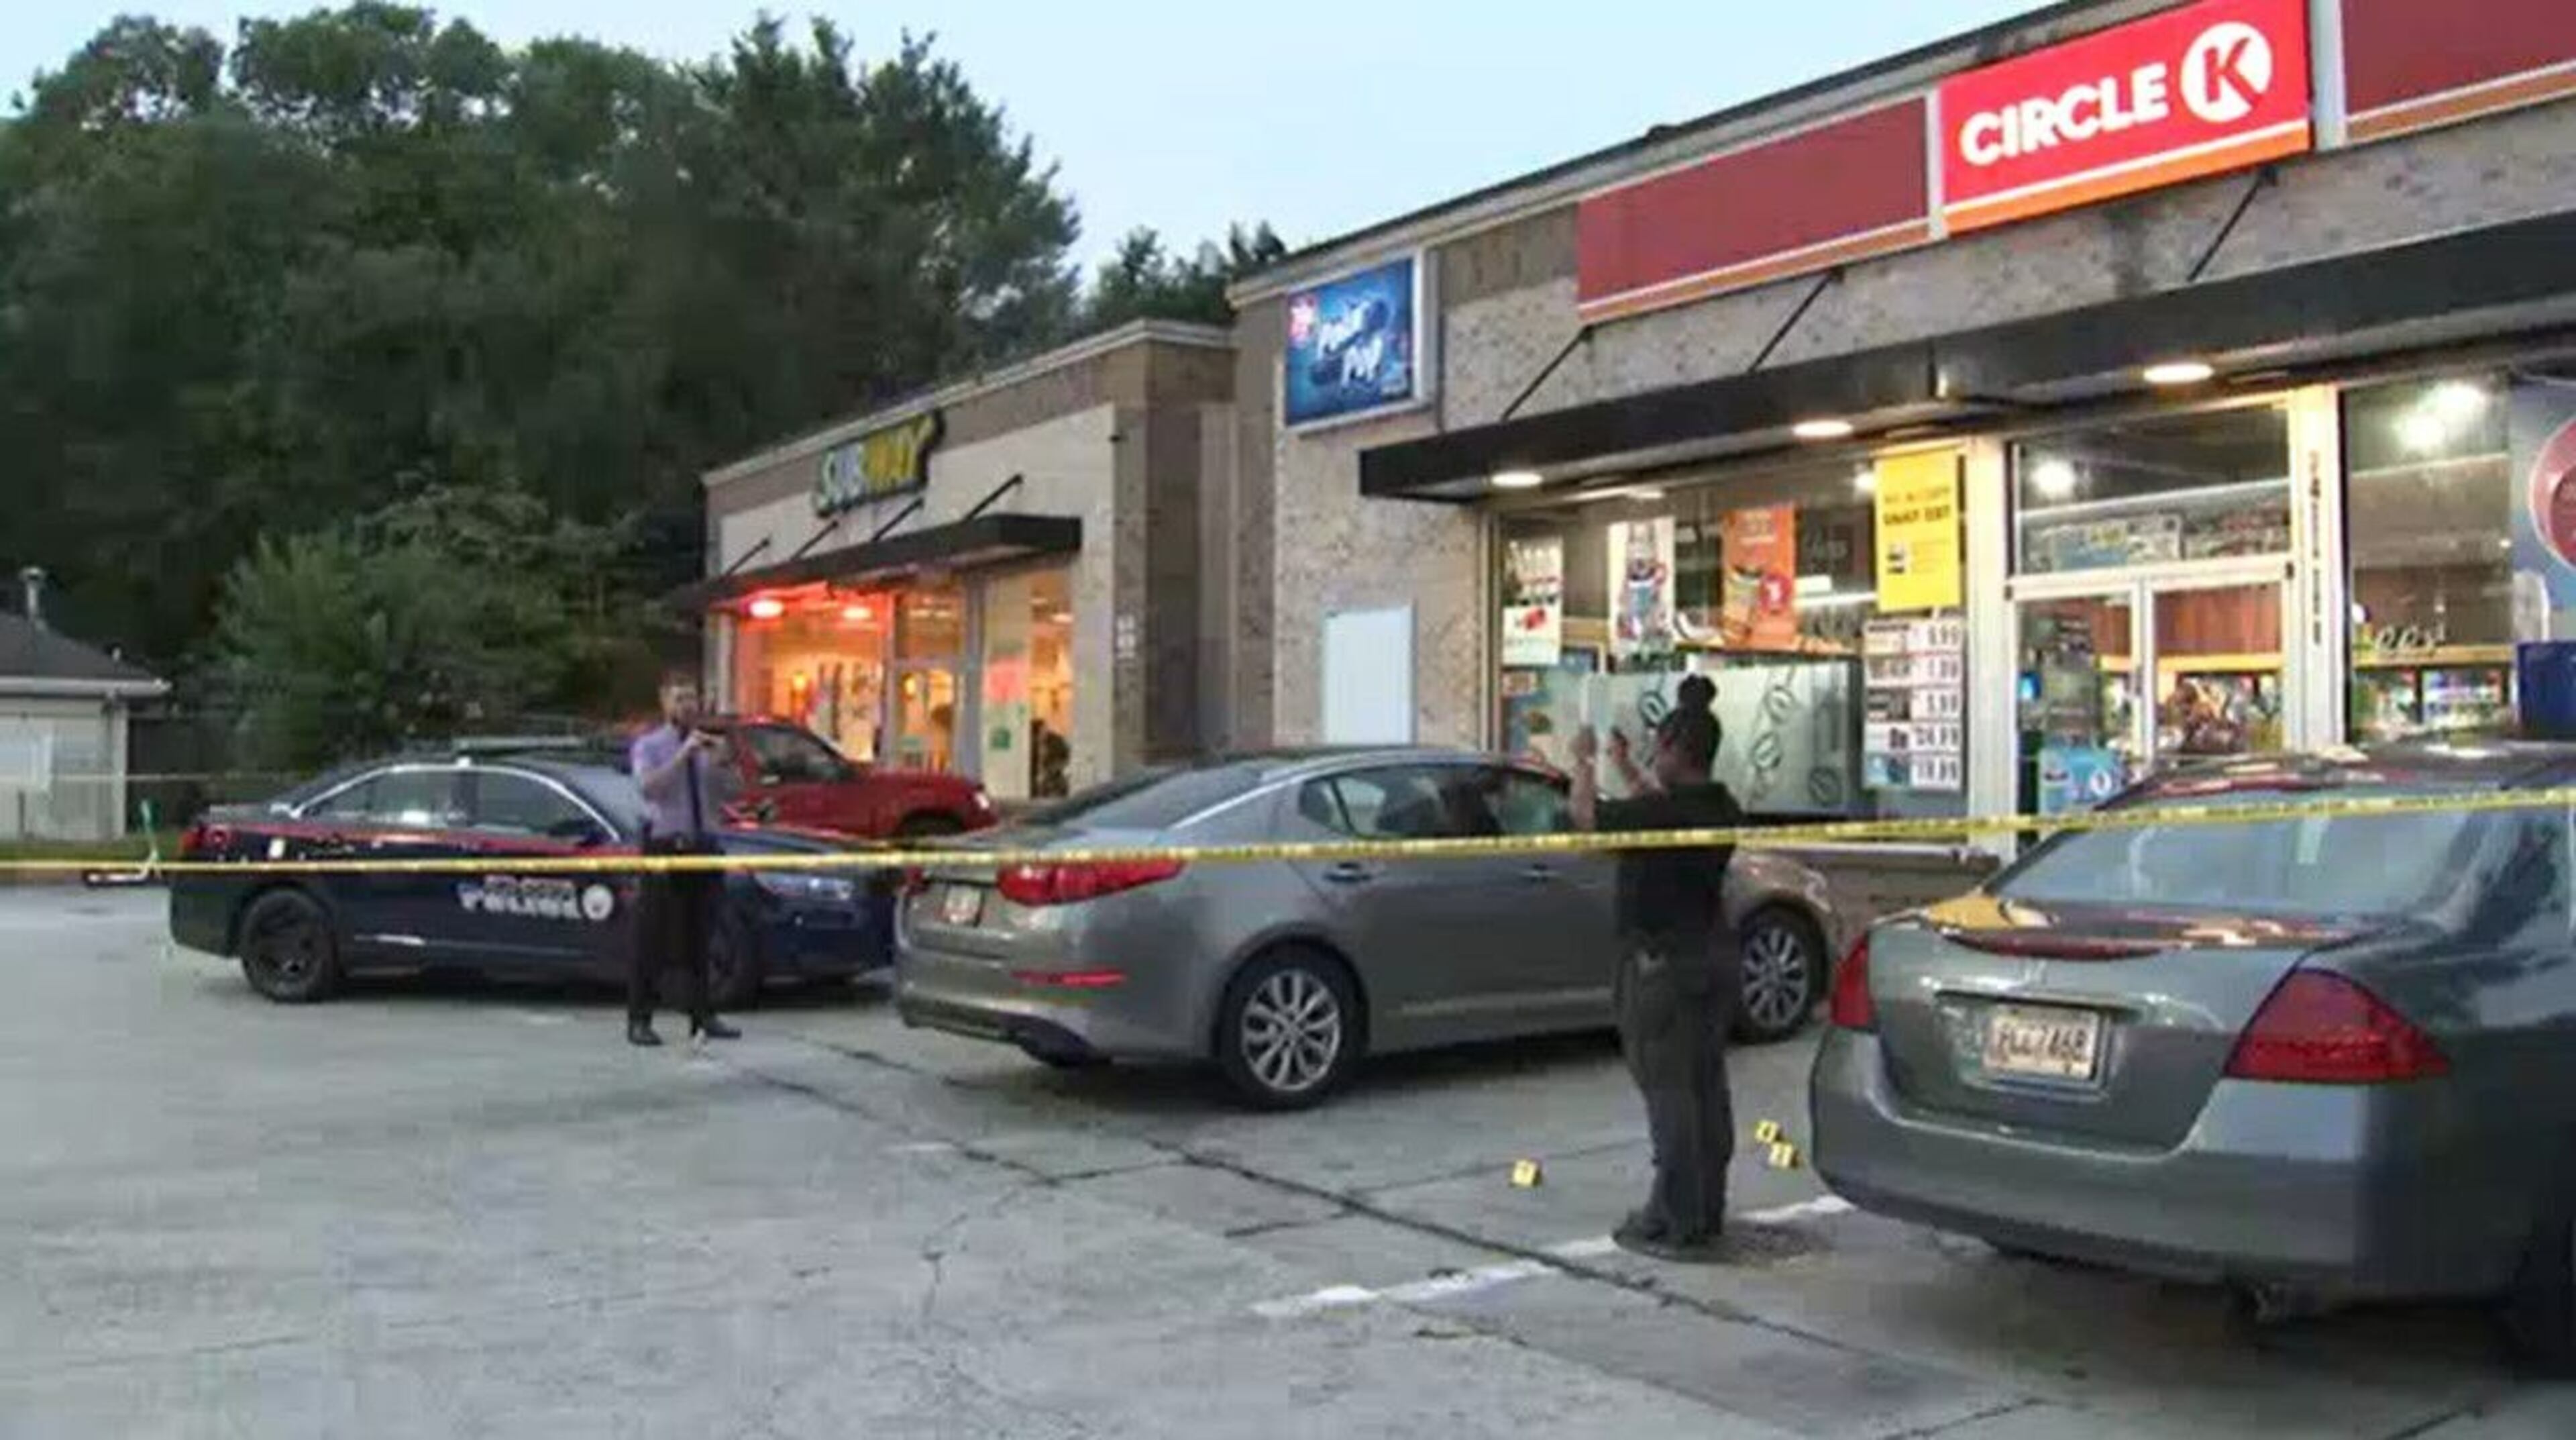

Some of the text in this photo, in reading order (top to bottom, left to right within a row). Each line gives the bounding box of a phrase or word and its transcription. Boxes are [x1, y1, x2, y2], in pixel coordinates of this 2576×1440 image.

[1960, 34, 2269, 166] CIRCLE K
[820, 413, 934, 507] SUBWAY
